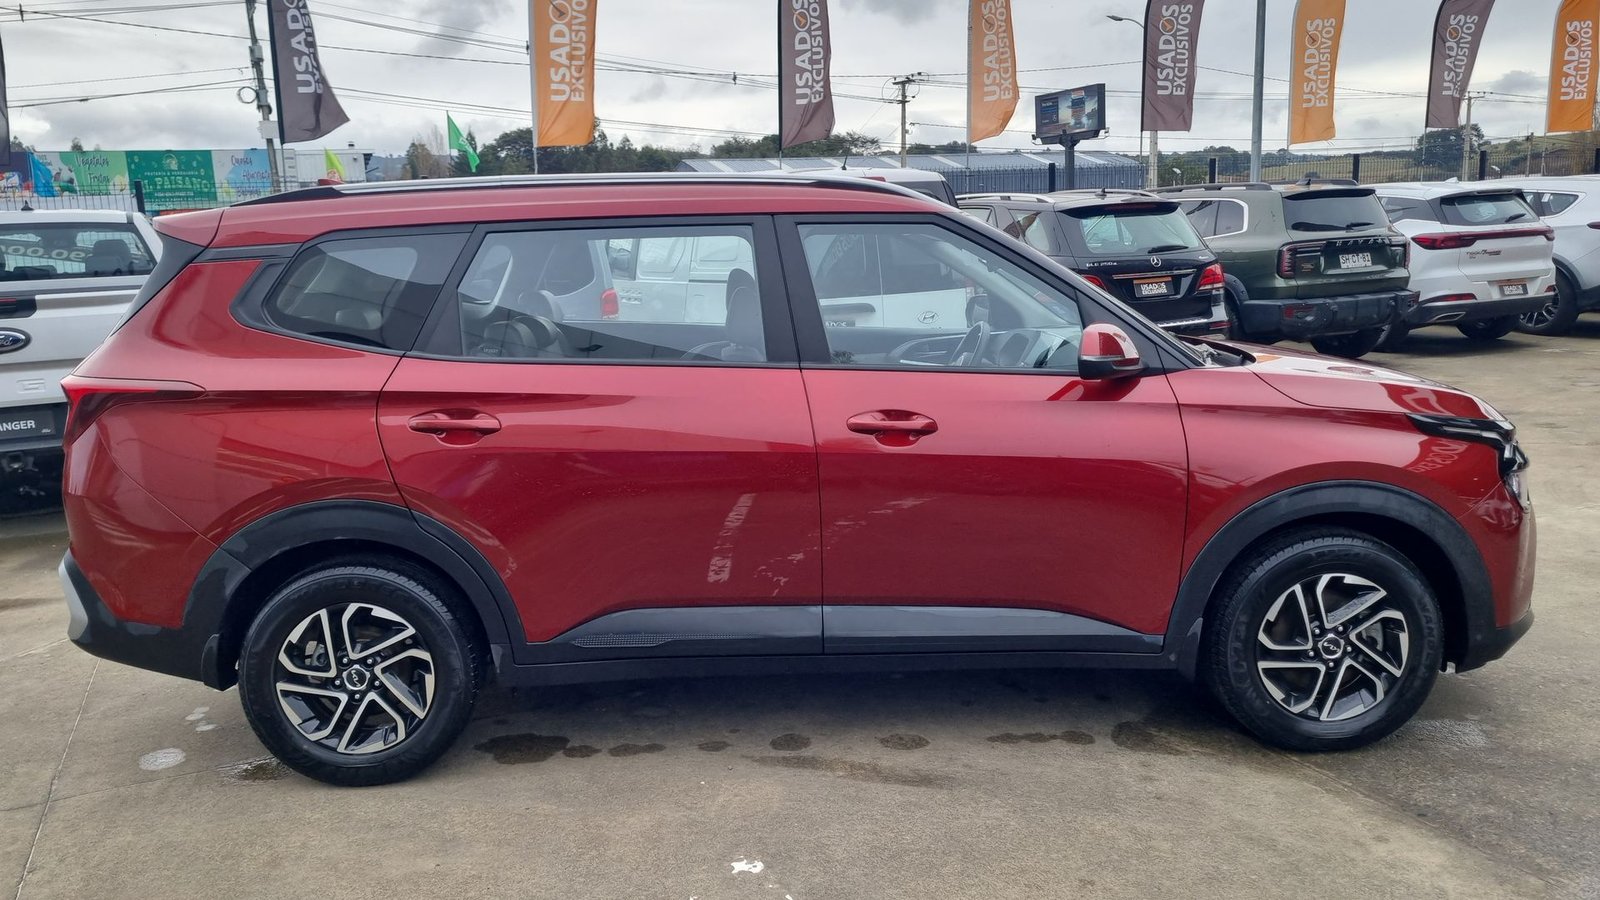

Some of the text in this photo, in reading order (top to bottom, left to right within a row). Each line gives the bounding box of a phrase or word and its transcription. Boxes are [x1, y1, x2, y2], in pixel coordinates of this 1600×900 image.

[284, 0, 315, 93] USAD
[549, 0, 571, 101] USADO
[571, 0, 588, 101] EXCLUSIVO
[809, 0, 824, 103] EXCLUSIVO
[982, 2, 1000, 102] USADOS
[995, 0, 1012, 99] EXCLUSIVOS
[1157, 4, 1180, 95] USADOS
[1173, 4, 1193, 95] EXCLUSIVOS
[1303, 18, 1323, 108] USADOS
[1316, 18, 1336, 107] EXCLUSIVOS
[1442, 14, 1466, 96] USADOS
[1560, 21, 1581, 100] USADOS
[1575, 20, 1593, 100] EXCLUSIVOS
[155, 176, 210, 192] PAISANO
[0, 420, 36, 431] NGER
